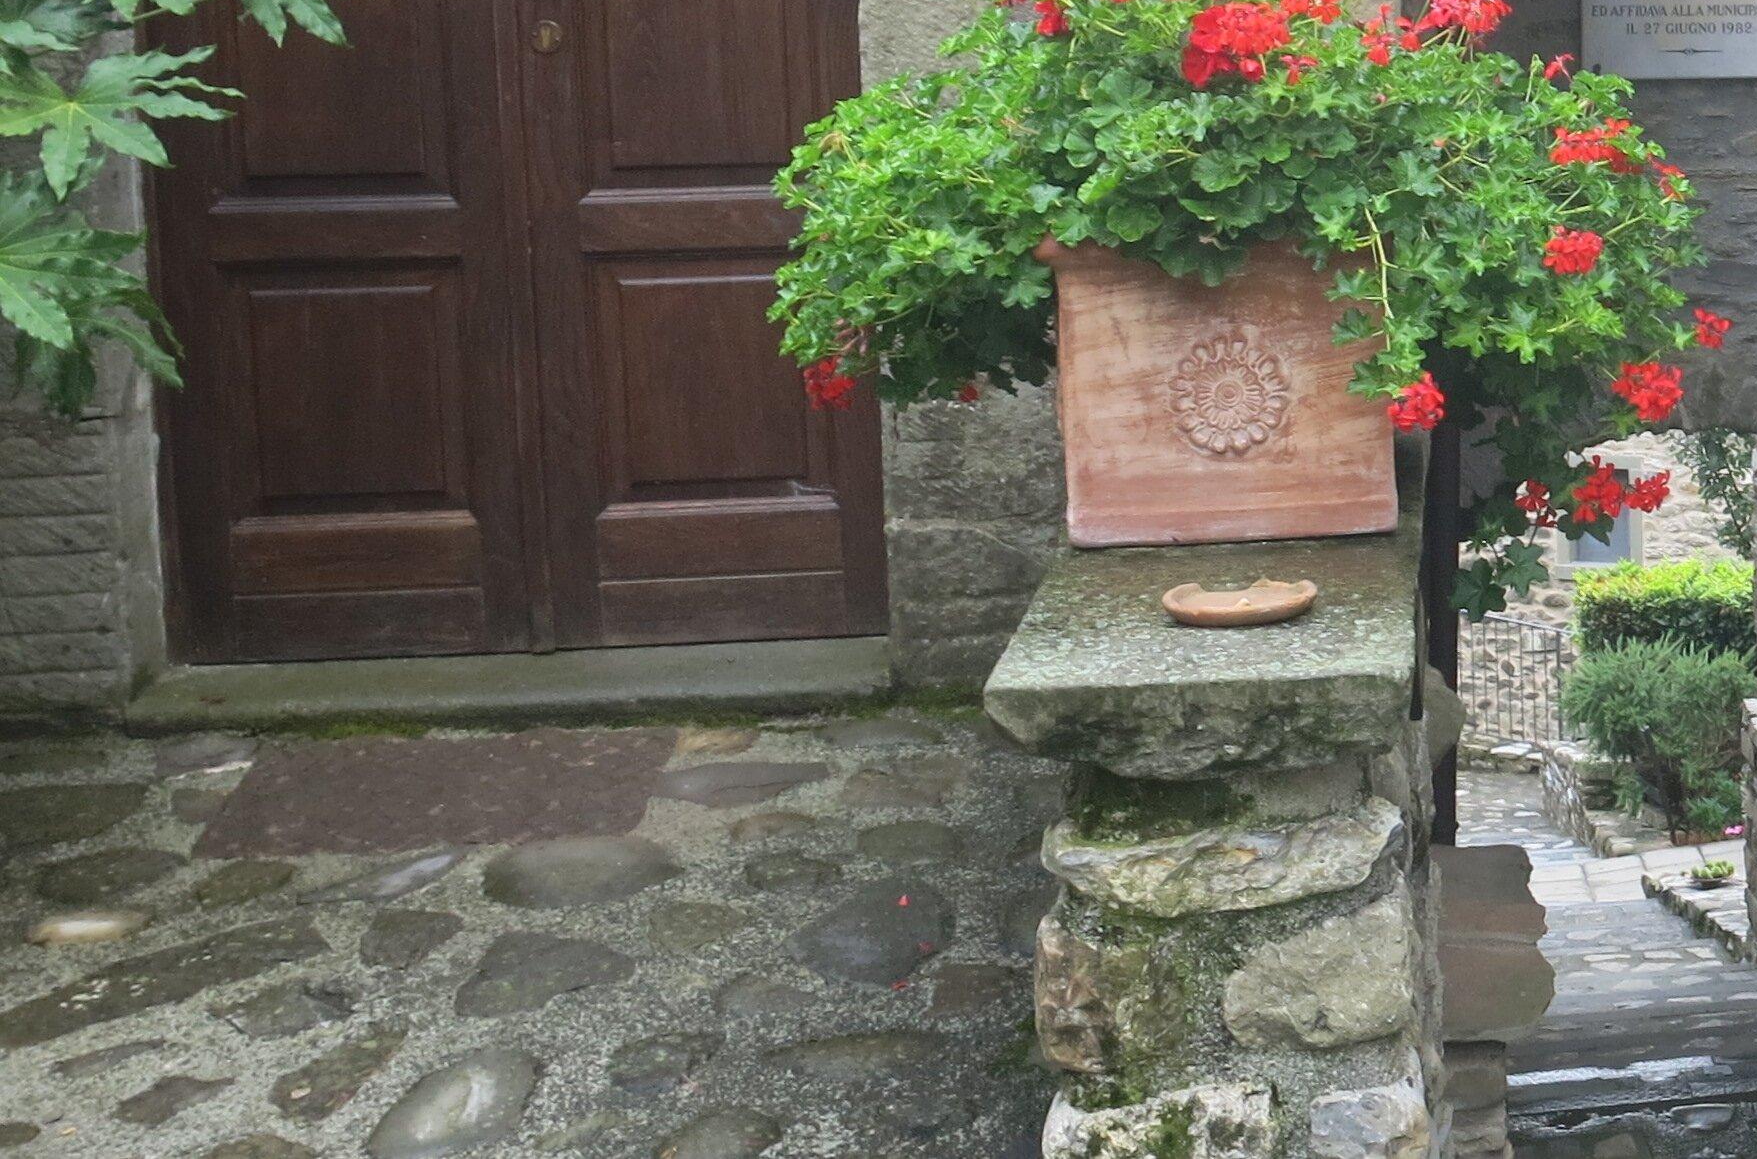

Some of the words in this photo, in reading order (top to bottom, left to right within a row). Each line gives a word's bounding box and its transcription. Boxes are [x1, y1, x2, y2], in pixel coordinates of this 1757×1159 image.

[1592, 4, 1607, 16] ED
[1610, 4, 1667, 17] AFFIDAVA
[1671, 4, 1704, 17] ALLA
[1626, 22, 1637, 34] IL
[1644, 22, 1660, 34] 27
[1665, 22, 1717, 34] GIUGNO
